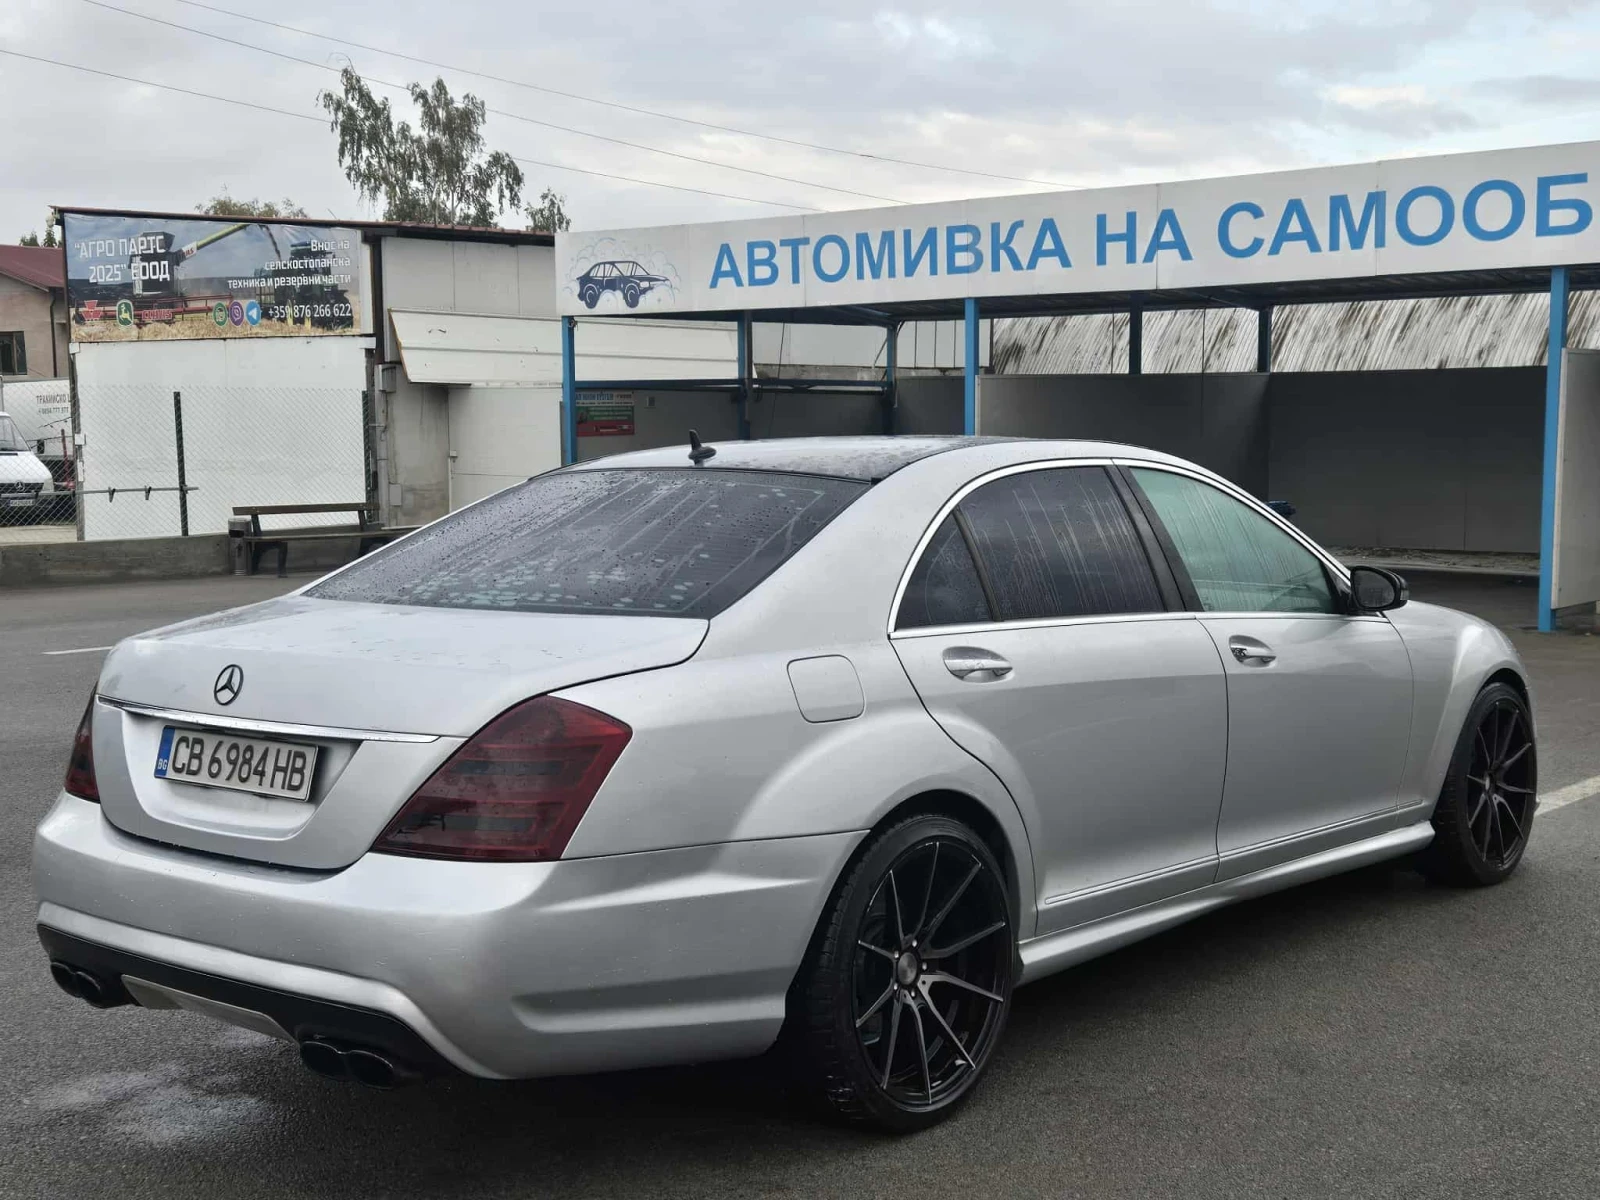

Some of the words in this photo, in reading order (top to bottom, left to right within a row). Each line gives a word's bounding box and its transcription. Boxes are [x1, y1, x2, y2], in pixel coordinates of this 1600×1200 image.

[709, 217, 1072, 289] АВТОМИВКА
[1095, 209, 1193, 267] НА
[1216, 171, 1594, 259] САМООБ
[119, 235, 166, 256] ПАРТС
[310, 239, 337, 252] Внос
[337, 239, 350, 250] на
[131, 260, 170, 282] ЕООД
[264, 257, 351, 271] селскостопанска
[227, 277, 265, 289] техника
[267, 278, 273, 287] и
[274, 275, 321, 289] резервни
[321, 274, 351, 285] части
[268, 305, 292, 318] +359
[293, 304, 311, 318] 876
[313, 304, 331, 317] 266
[333, 303, 352, 316] 622
[157, 758, 168, 770] BG
